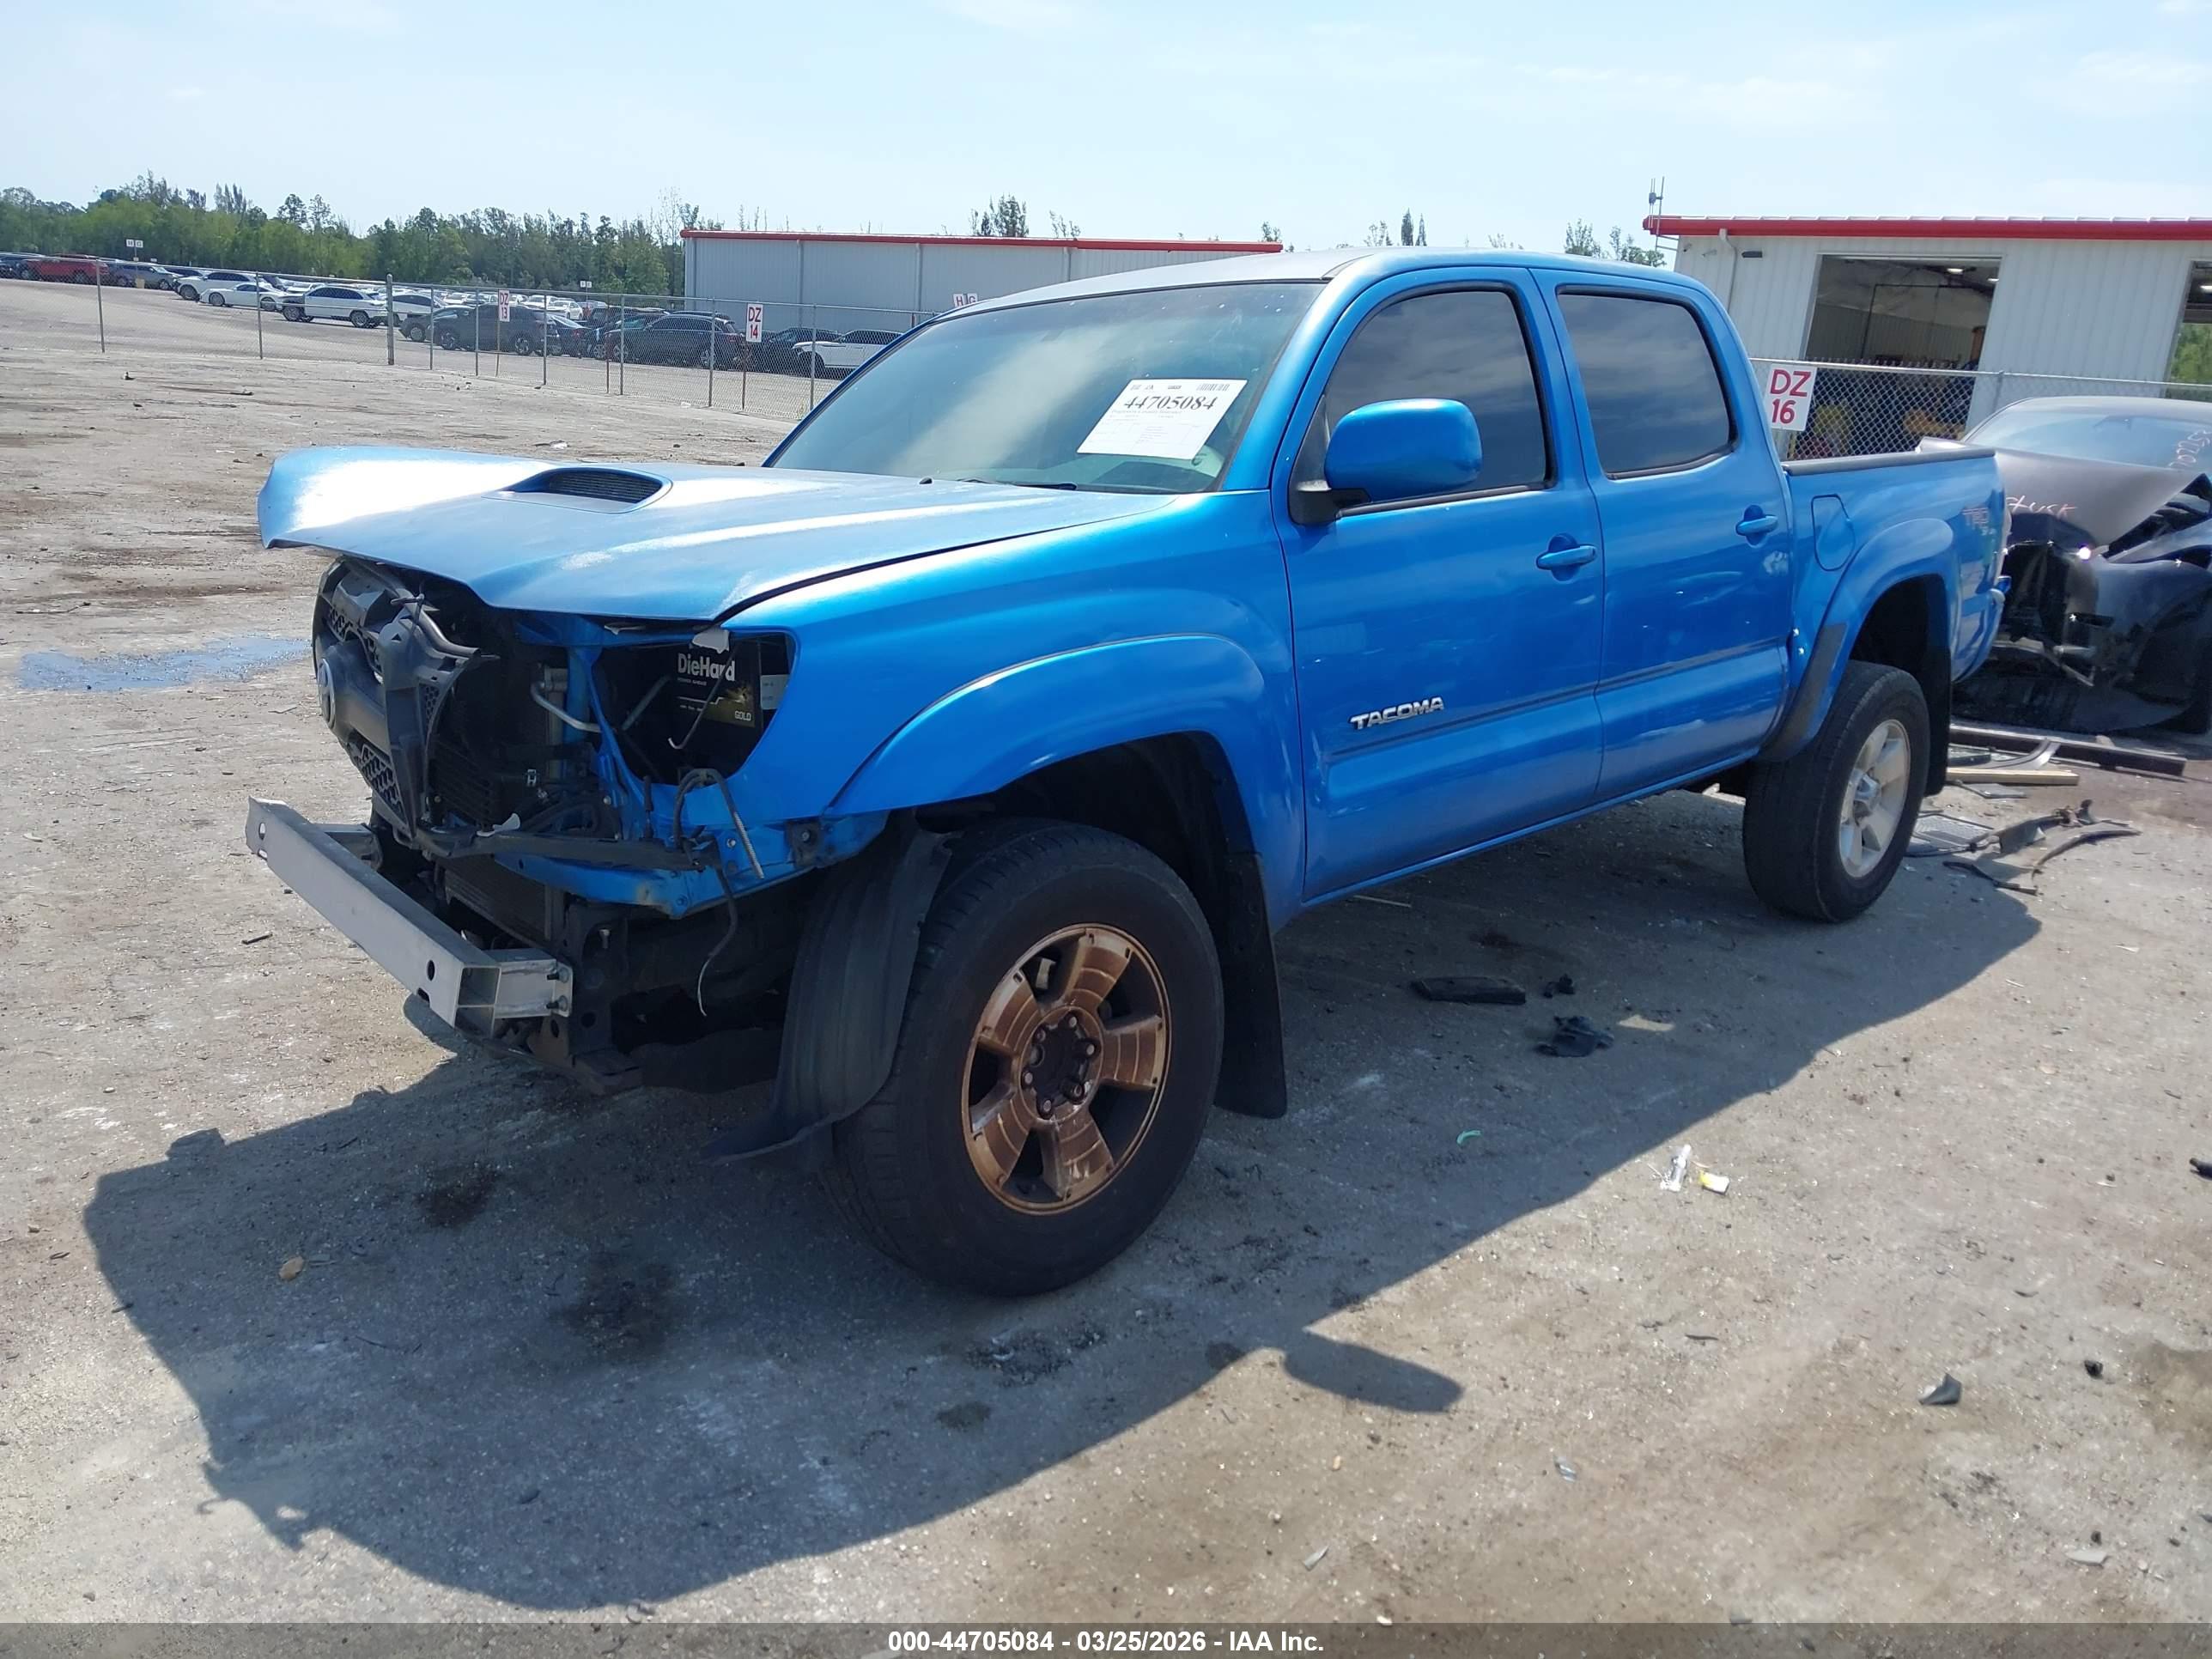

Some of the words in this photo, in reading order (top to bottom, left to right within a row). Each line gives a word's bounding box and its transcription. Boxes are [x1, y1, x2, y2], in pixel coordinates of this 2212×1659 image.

[500, 293, 509, 306] DZ
[956, 295, 963, 307] H
[501, 307, 507, 319] 13
[748, 307, 762, 323] DZ
[750, 324, 758, 339] 14
[1770, 368, 1812, 398] DZ
[1124, 395, 1218, 410] 44705084
[1771, 398, 1796, 424] 16
[677, 653, 736, 682] DieHard
[734, 710, 751, 721] GOLD
[1349, 696, 1444, 730] TACOMA
